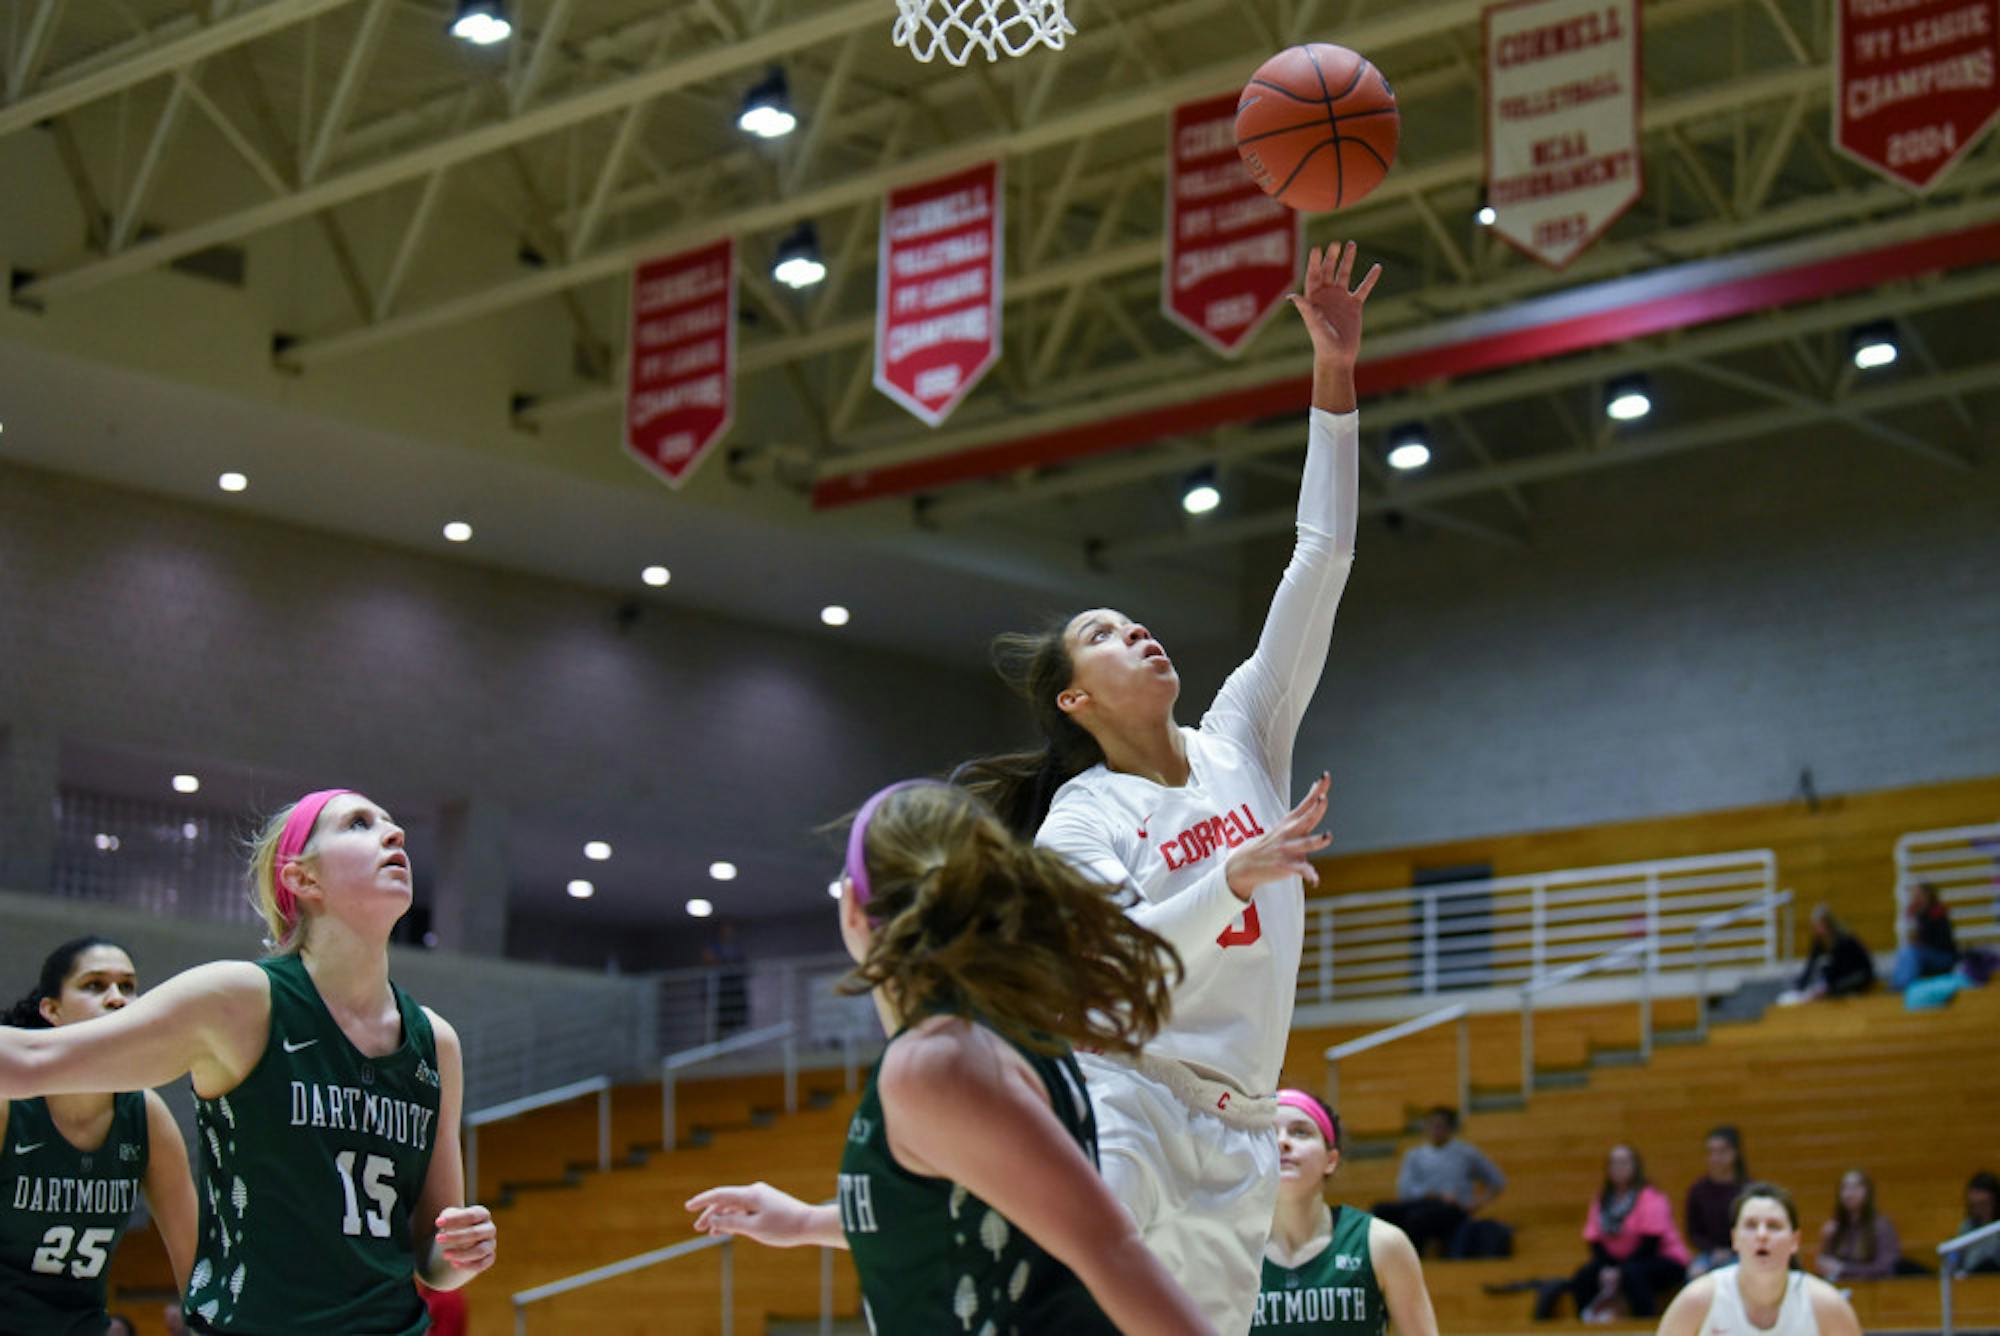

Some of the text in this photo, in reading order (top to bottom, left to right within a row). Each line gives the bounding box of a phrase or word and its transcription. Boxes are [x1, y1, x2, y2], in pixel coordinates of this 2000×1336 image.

[1497, 5, 1622, 71] CORNELL
[1898, 2, 1990, 53] LEAGUE
[1847, 46, 1994, 121] CHAMPIONS
[1180, 116, 1238, 159] CORN
[1160, 803, 1264, 872] CORNELL
[290, 1080, 433, 1150] DARTMOUTH
[335, 1151, 398, 1237] 15
[32, 1225, 115, 1278] 25
[1253, 1287, 1366, 1327] RTMOUTH
